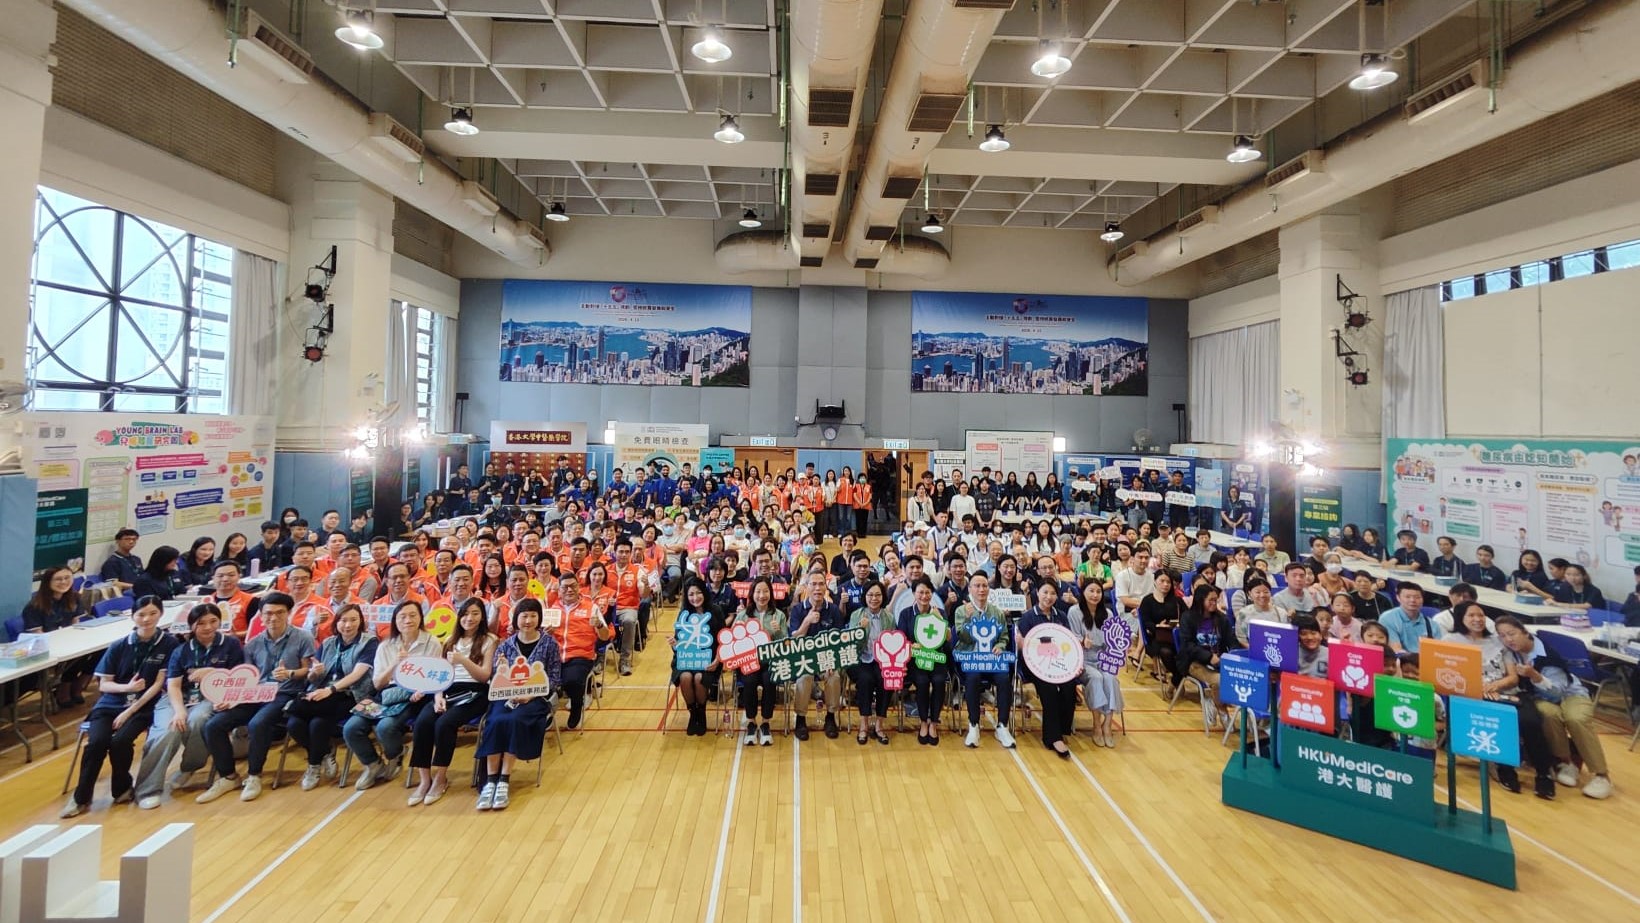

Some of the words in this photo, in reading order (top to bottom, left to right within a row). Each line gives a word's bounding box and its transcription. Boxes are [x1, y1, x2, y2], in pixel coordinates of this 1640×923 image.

[634, 436, 689, 445] 免費眼睛檢查
[759, 628, 865, 660] HKUMediCare
[726, 652, 758, 668] Commu
[912, 649, 945, 662] rotection
[972, 654, 1001, 662] Healthy
[1100, 652, 1124, 666] Shape
[771, 644, 860, 682] 港大醫護
[400, 661, 450, 684] 好人好事
[1236, 666, 1255, 676] Healthy
[212, 678, 246, 687] 中西區
[490, 686, 548, 698] 中西區民政事務處
[1290, 685, 1323, 697] Community
[1388, 688, 1420, 700] Protection
[1298, 746, 1414, 784] HKUMediCare
[1318, 766, 1392, 800] 港大醫護
